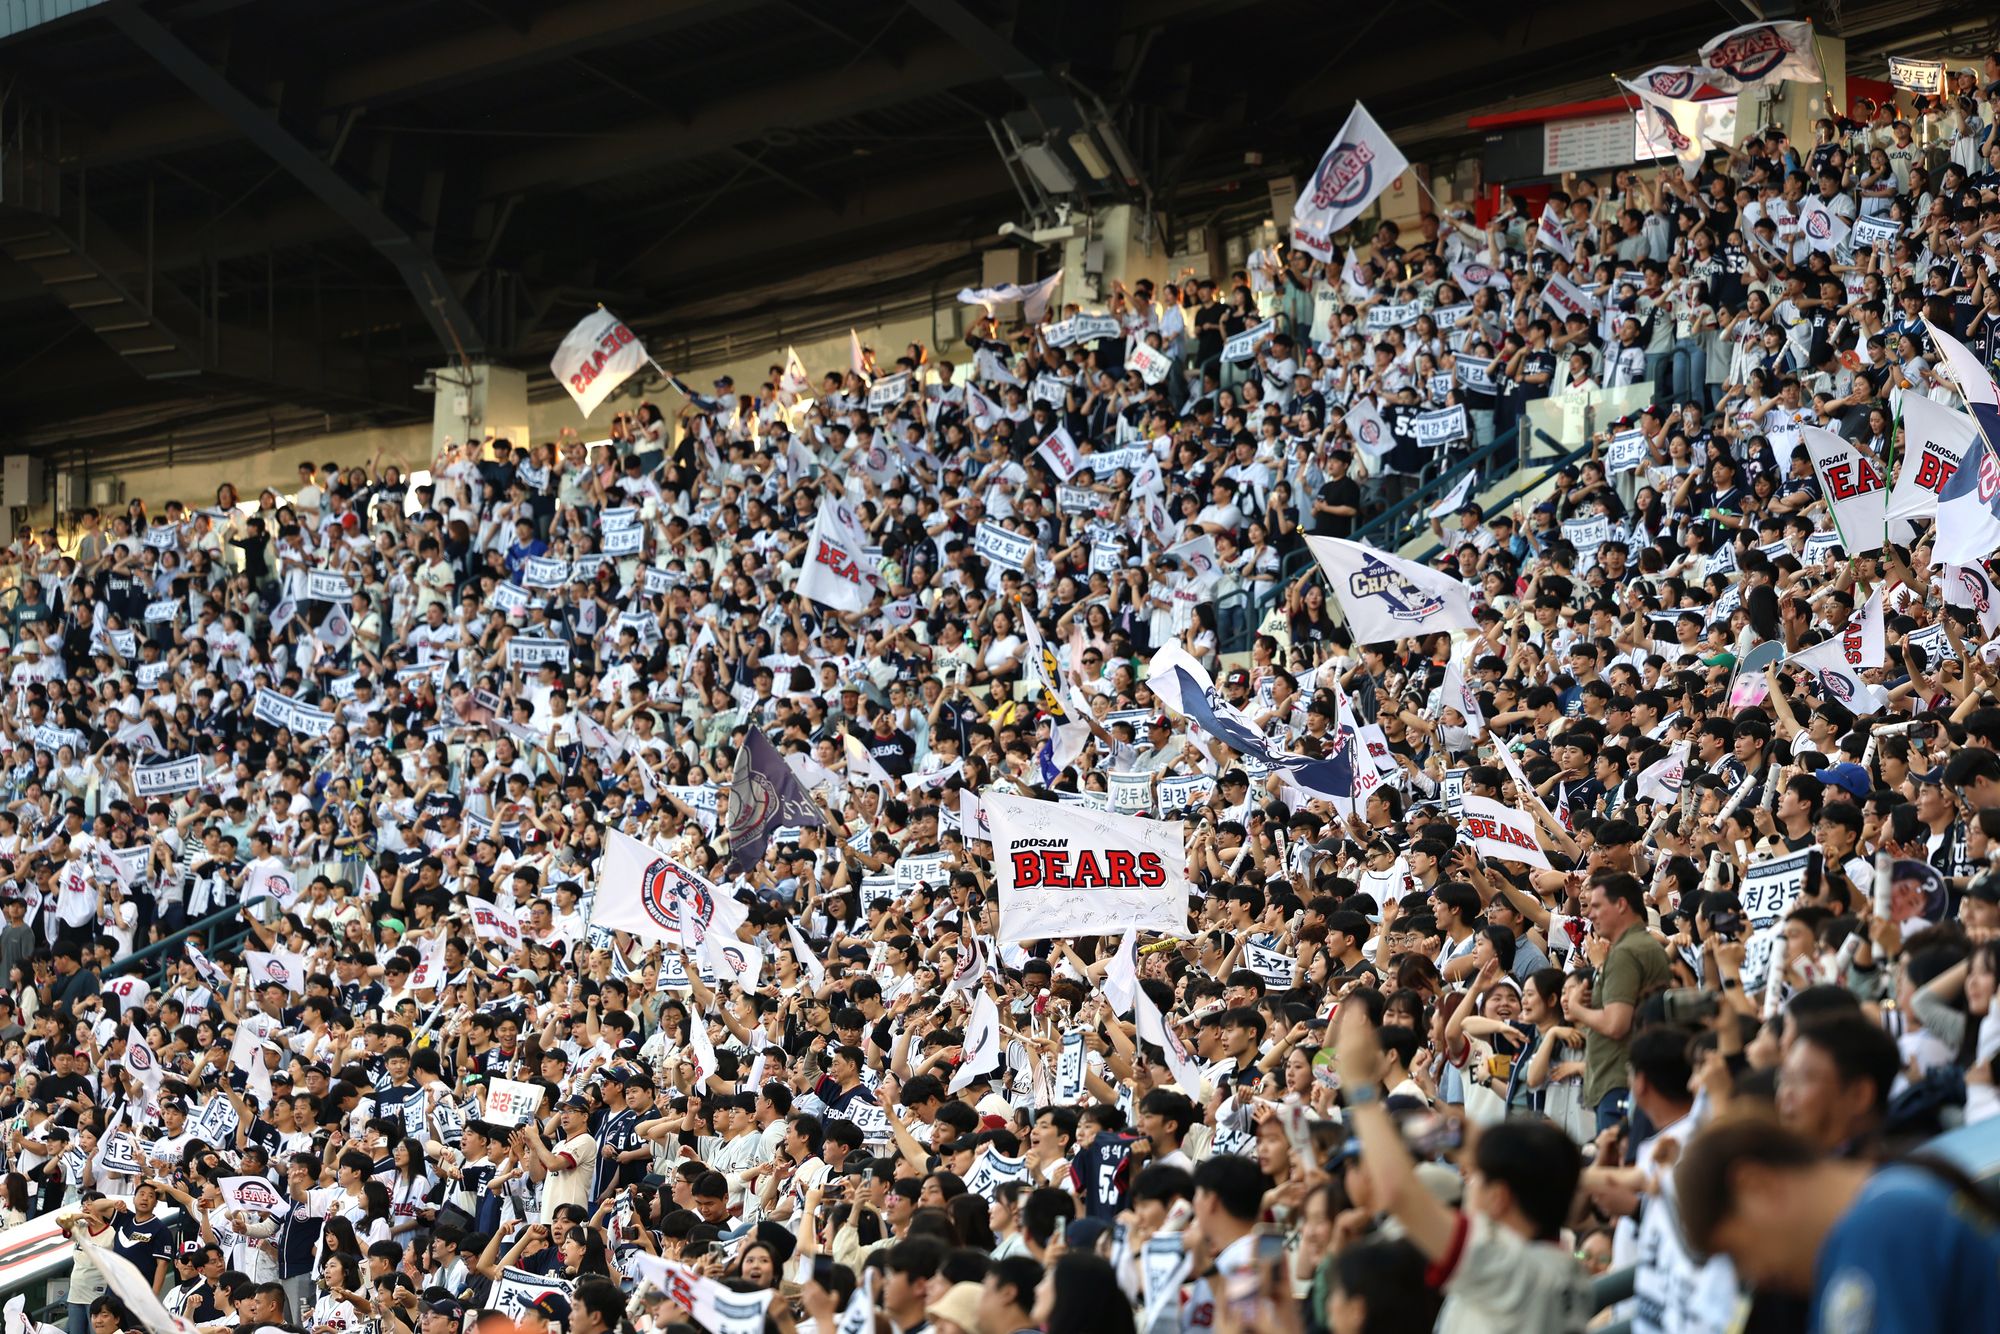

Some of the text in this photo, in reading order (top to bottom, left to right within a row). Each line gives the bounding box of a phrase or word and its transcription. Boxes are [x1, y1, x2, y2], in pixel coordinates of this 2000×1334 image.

[1891, 66, 1936, 85] 최강두산
[1046, 437, 1073, 474] BEARS
[1822, 459, 1884, 500] EA
[978, 532, 1027, 560] 최강두산
[1369, 567, 1386, 576] 2016
[1845, 614, 1863, 665] ARS
[512, 648, 566, 664] 최강두산
[871, 746, 902, 757] BEARS
[139, 766, 195, 786] 최강두산
[1010, 838, 1069, 851] DOOSAN
[1469, 818, 1538, 852] BEARS
[1011, 850, 1169, 889] BEARS
[69, 875, 86, 893] 53
[645, 900, 681, 930] PROFESSIONA
[111, 981, 132, 995] 18
[491, 1089, 533, 1116] 최강두산
[1098, 1165, 1118, 1204] 53
[234, 1188, 278, 1205] BEARS
